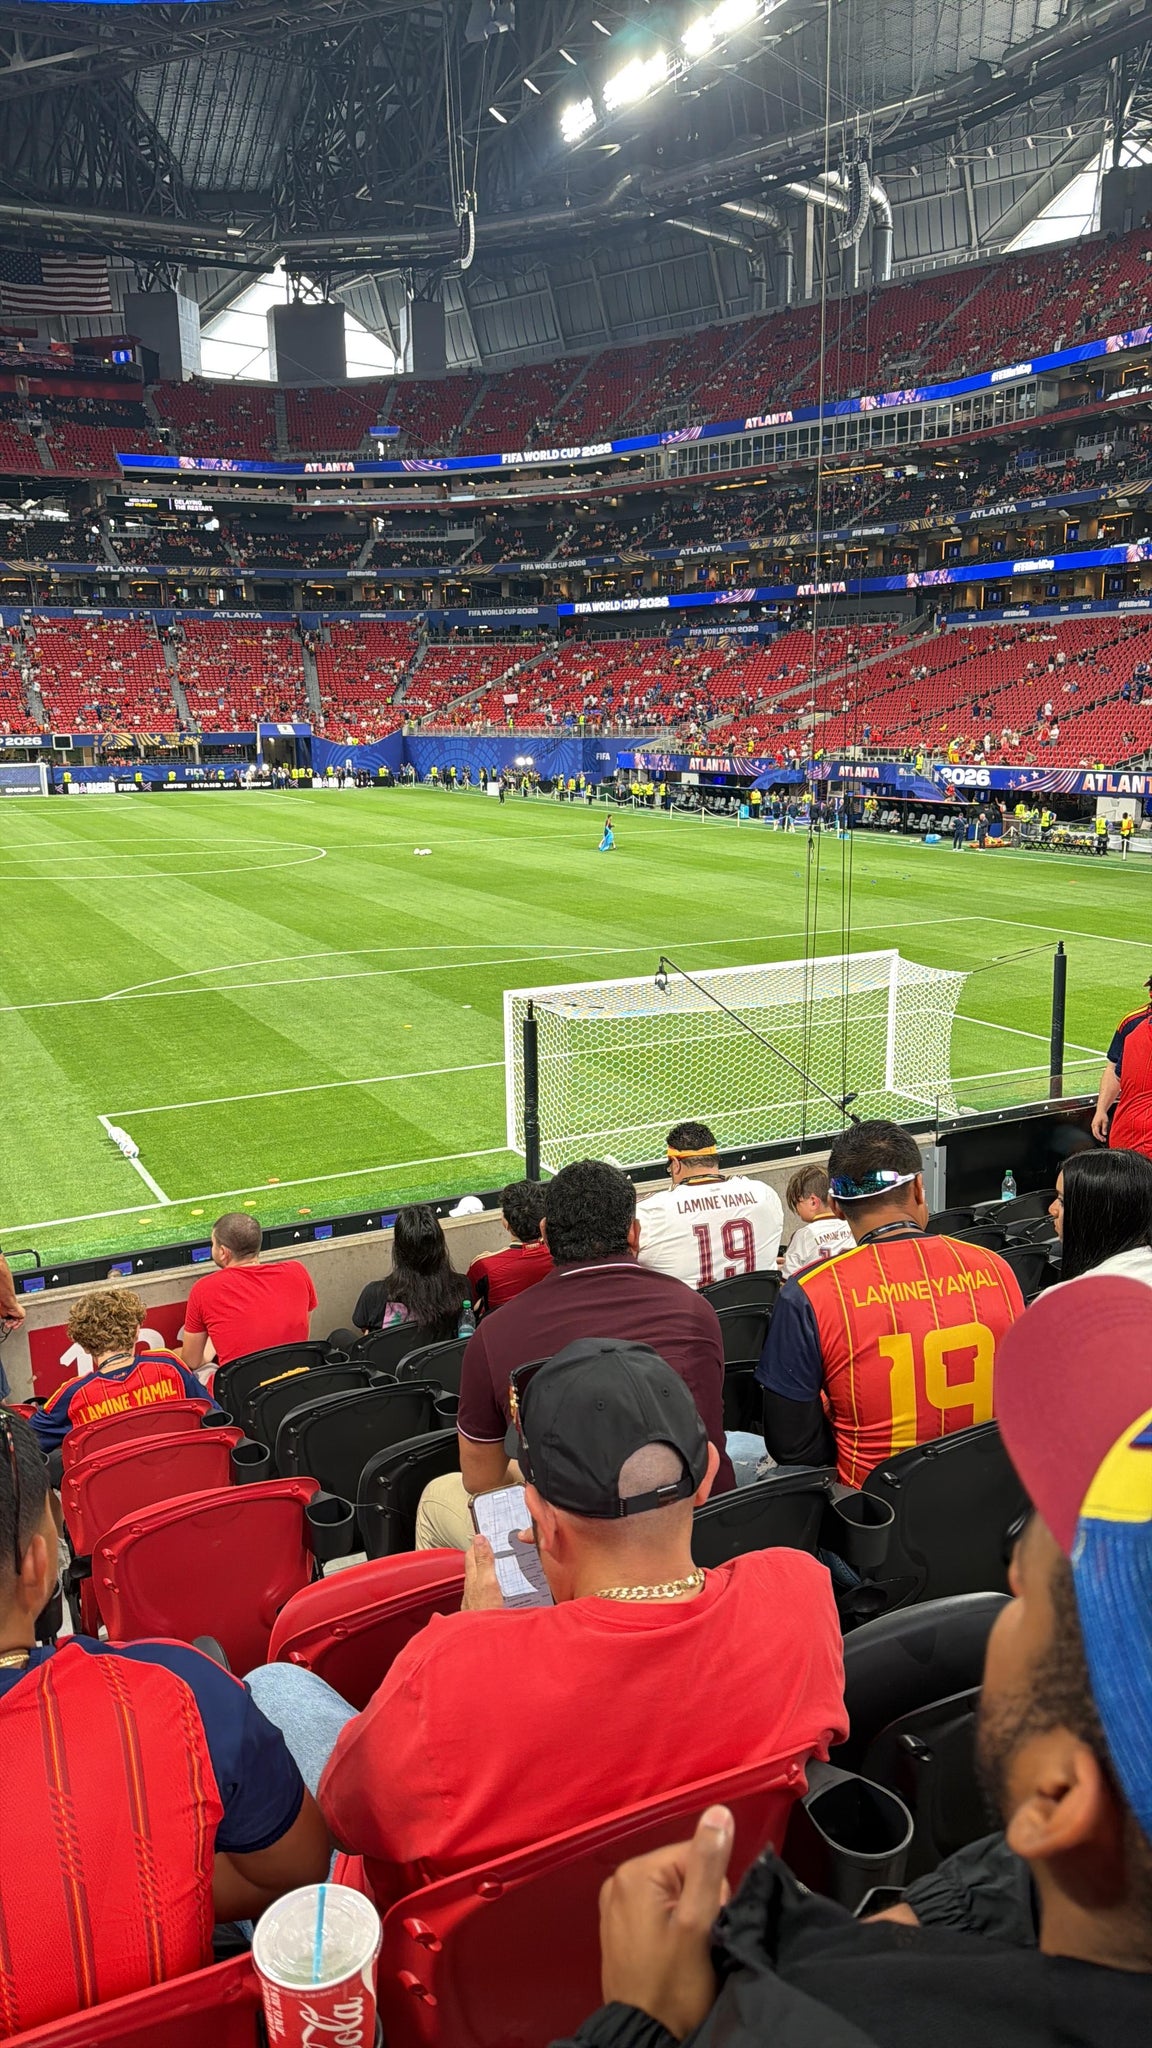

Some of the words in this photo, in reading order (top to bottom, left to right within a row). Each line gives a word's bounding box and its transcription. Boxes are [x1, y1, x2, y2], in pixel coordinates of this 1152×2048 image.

[744, 411, 794, 430] ATLANTA
[502, 453, 524, 464] FIFA
[524, 450, 560, 463] WORLD
[560, 447, 581, 459] CUP
[581, 443, 613, 457] 2026
[304, 462, 355, 473] ATLANTA
[970, 504, 1017, 520] ATLANTA
[679, 544, 722, 556] ATLANTA
[95, 565, 149, 574] ATLANTA
[535, 562, 557, 570] WORLD
[558, 561, 568, 569] CUP
[568, 559, 586, 567] 2026
[796, 582, 846, 596] ATLANTA
[482, 608, 503, 616] WORLD
[516, 607, 539, 615] 2026
[574, 604, 592, 614] FIFA
[592, 602, 620, 612] WORLD
[621, 600, 639, 610] CUP
[639, 597, 670, 609] 2026
[212, 611, 263, 619] ATLANTA
[724, 626, 736, 634] CUP
[737, 625, 759, 633] 2026
[5, 736, 42, 746] 2026
[596, 752, 610, 761] FIFA
[185, 768, 204, 776] FIFA
[688, 758, 731, 772] ATLANTA
[838, 766, 880, 778] ATLANTA
[940, 768, 990, 786] 2026
[676, 1195, 721, 1214] LAMINE
[721, 1192, 758, 1208] YAMAL
[814, 1230, 839, 1246] LAMINE
[692, 1217, 756, 1288] 19
[851, 1280, 932, 1308] LAMINE
[932, 1268, 999, 1298] YAMAL
[878, 1321, 996, 1457] 19
[78, 1394, 130, 1424] LAMINE
[132, 1378, 178, 1406] YAMAL
